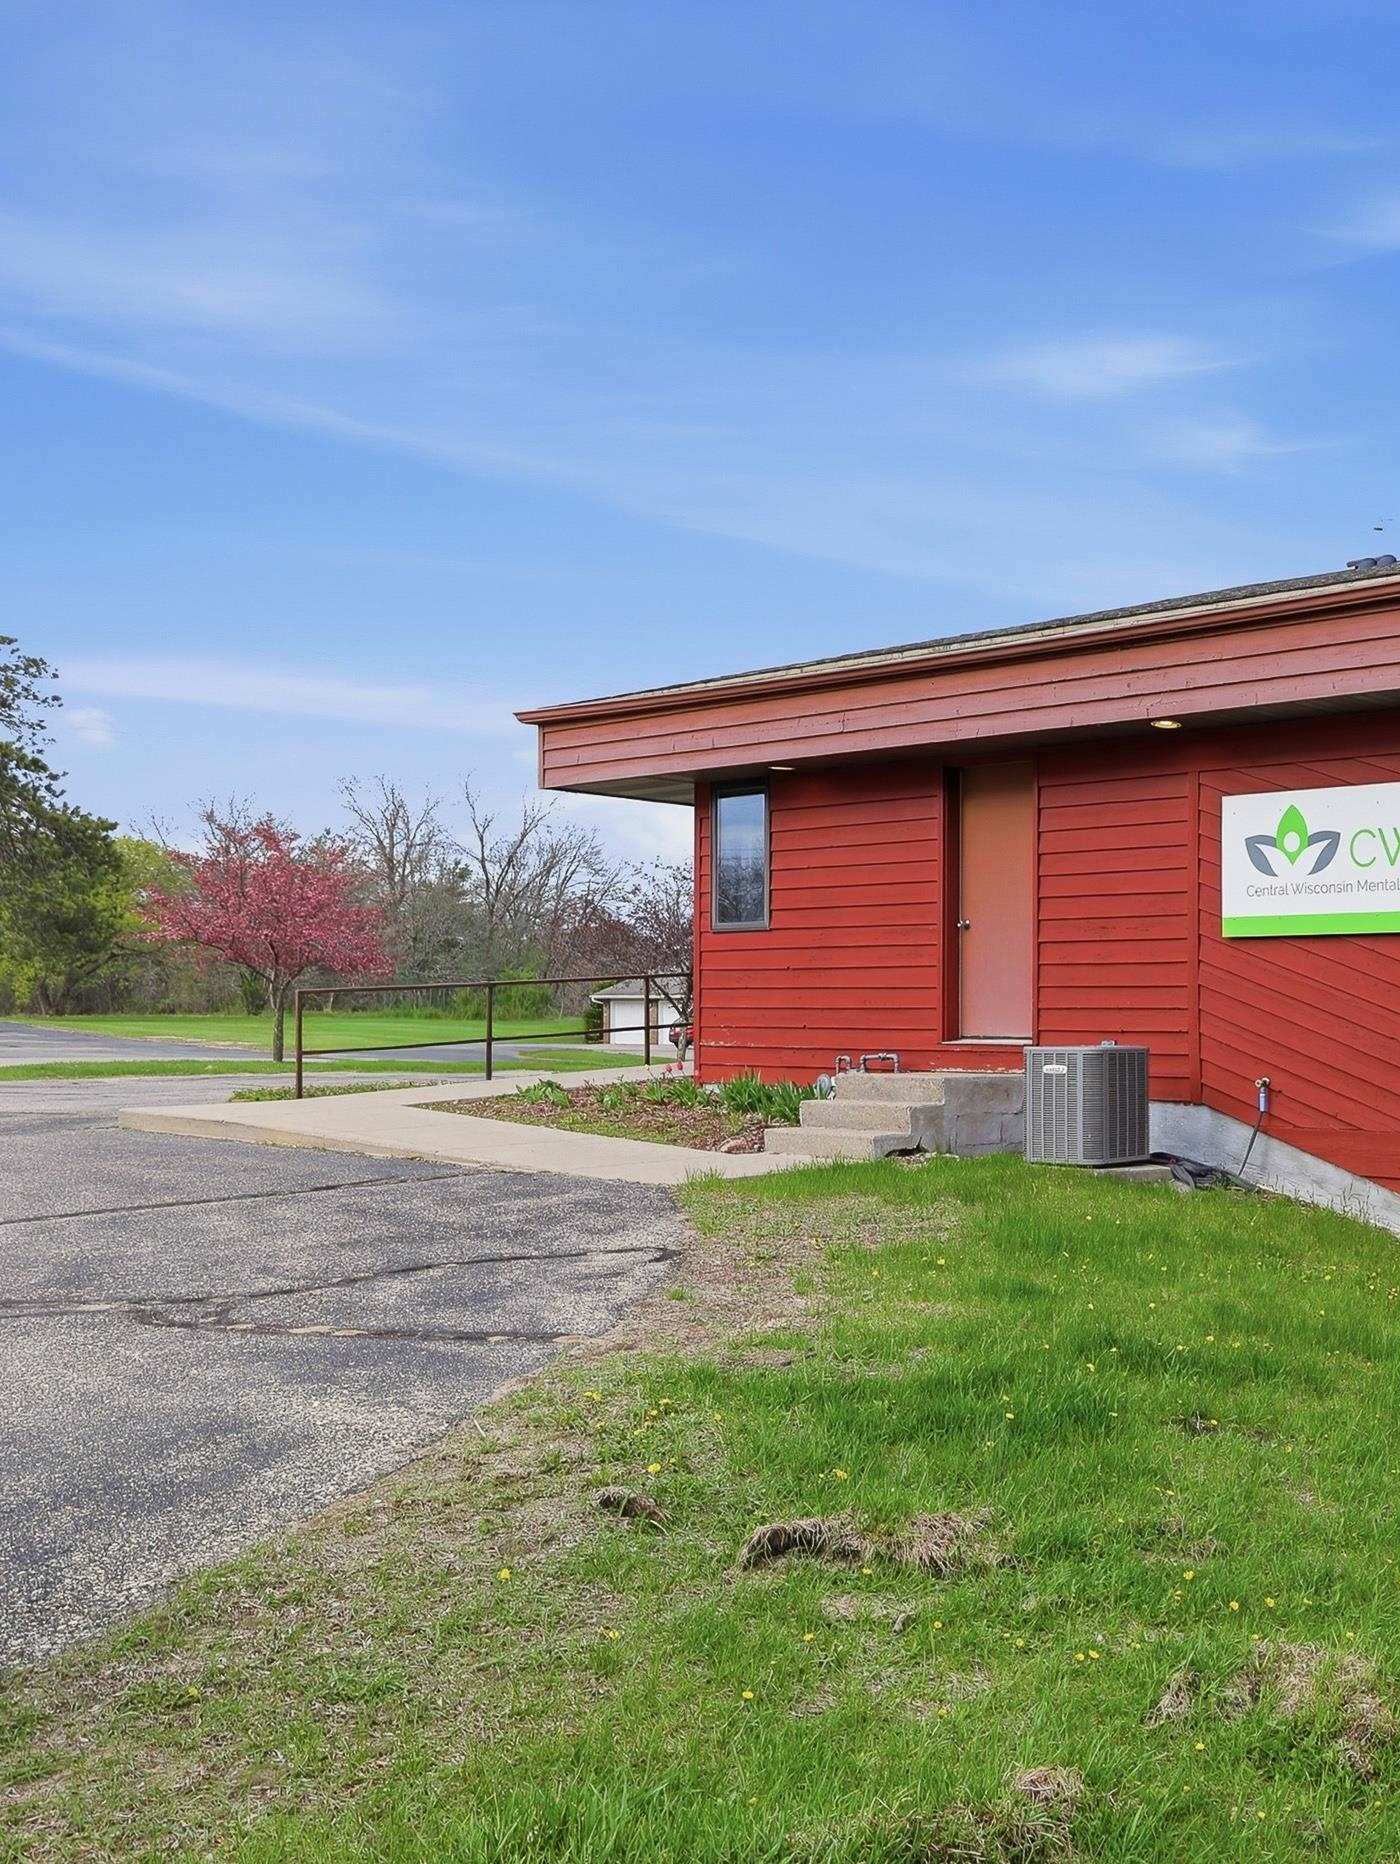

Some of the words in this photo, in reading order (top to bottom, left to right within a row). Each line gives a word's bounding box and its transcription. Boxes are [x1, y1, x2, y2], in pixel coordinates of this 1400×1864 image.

[1246, 884, 1289, 898] Central
[1291, 879, 1354, 896] Wisconsin
[1357, 876, 1400, 893] Mental
